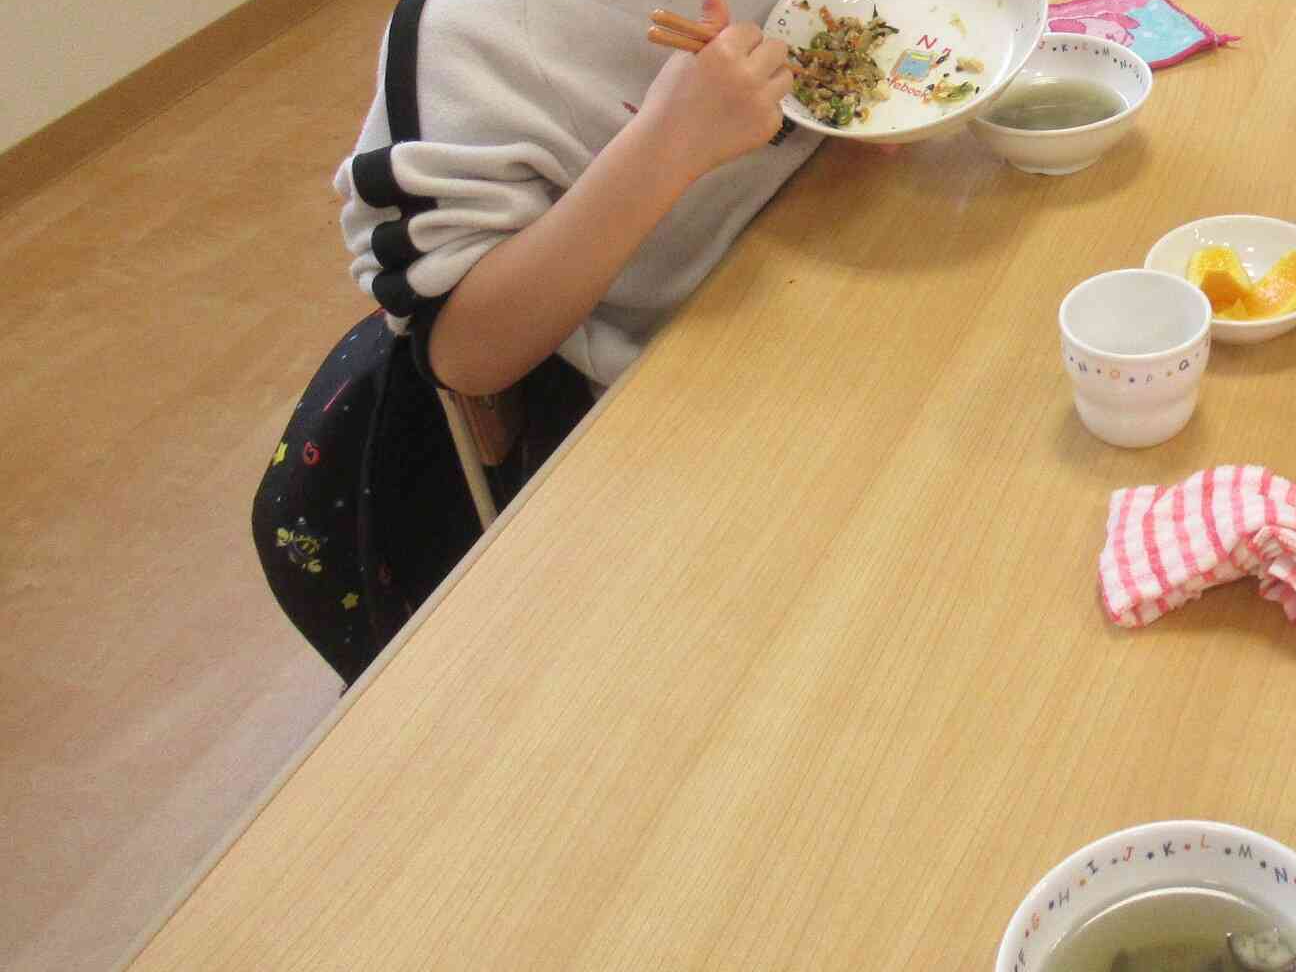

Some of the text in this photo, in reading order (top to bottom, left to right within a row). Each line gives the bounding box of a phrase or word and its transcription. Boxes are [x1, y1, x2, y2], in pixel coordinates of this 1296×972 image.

[915, 34, 939, 50] N
[1161, 841, 1176, 858] K
[1237, 844, 1254, 860] M
